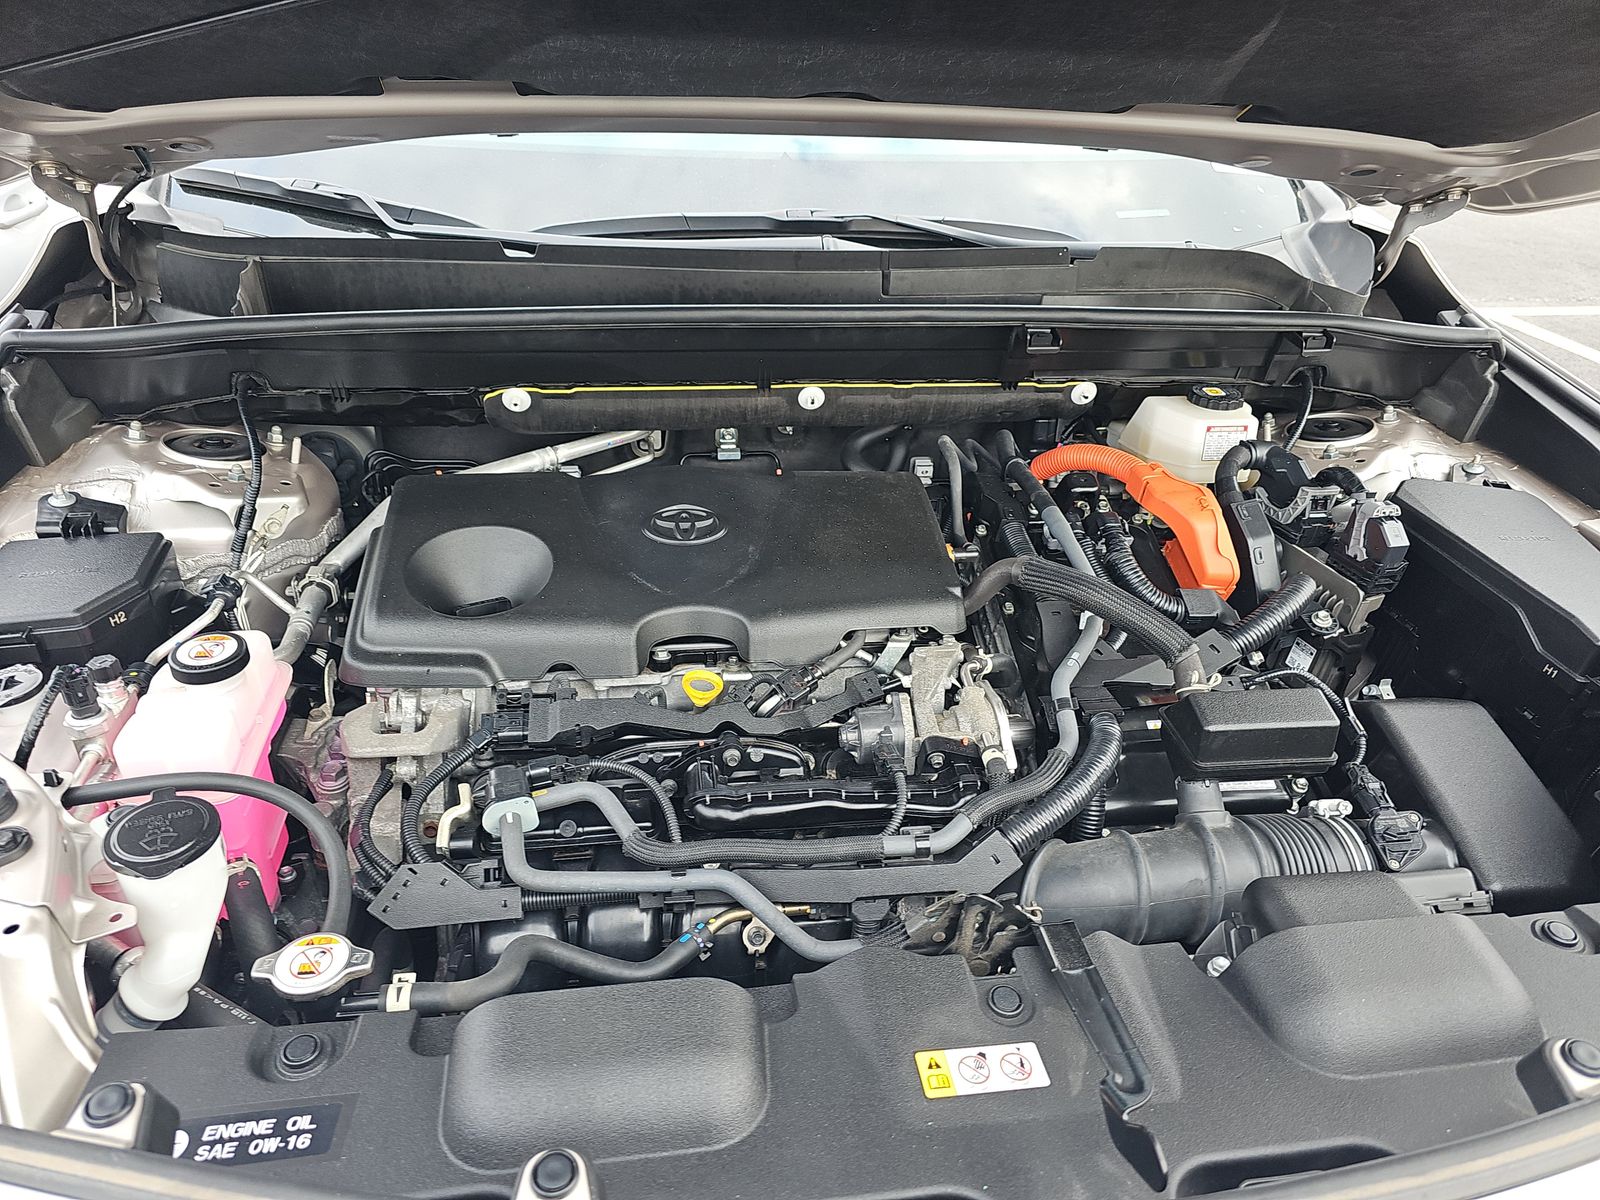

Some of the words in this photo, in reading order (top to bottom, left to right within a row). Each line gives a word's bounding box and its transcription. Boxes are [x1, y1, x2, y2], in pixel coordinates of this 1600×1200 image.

[109, 611, 127, 627] H2
[1542, 663, 1558, 678] H1
[201, 1118, 277, 1141] ENGINE
[286, 1115, 317, 1131] OIL
[194, 1142, 239, 1161] SAE
